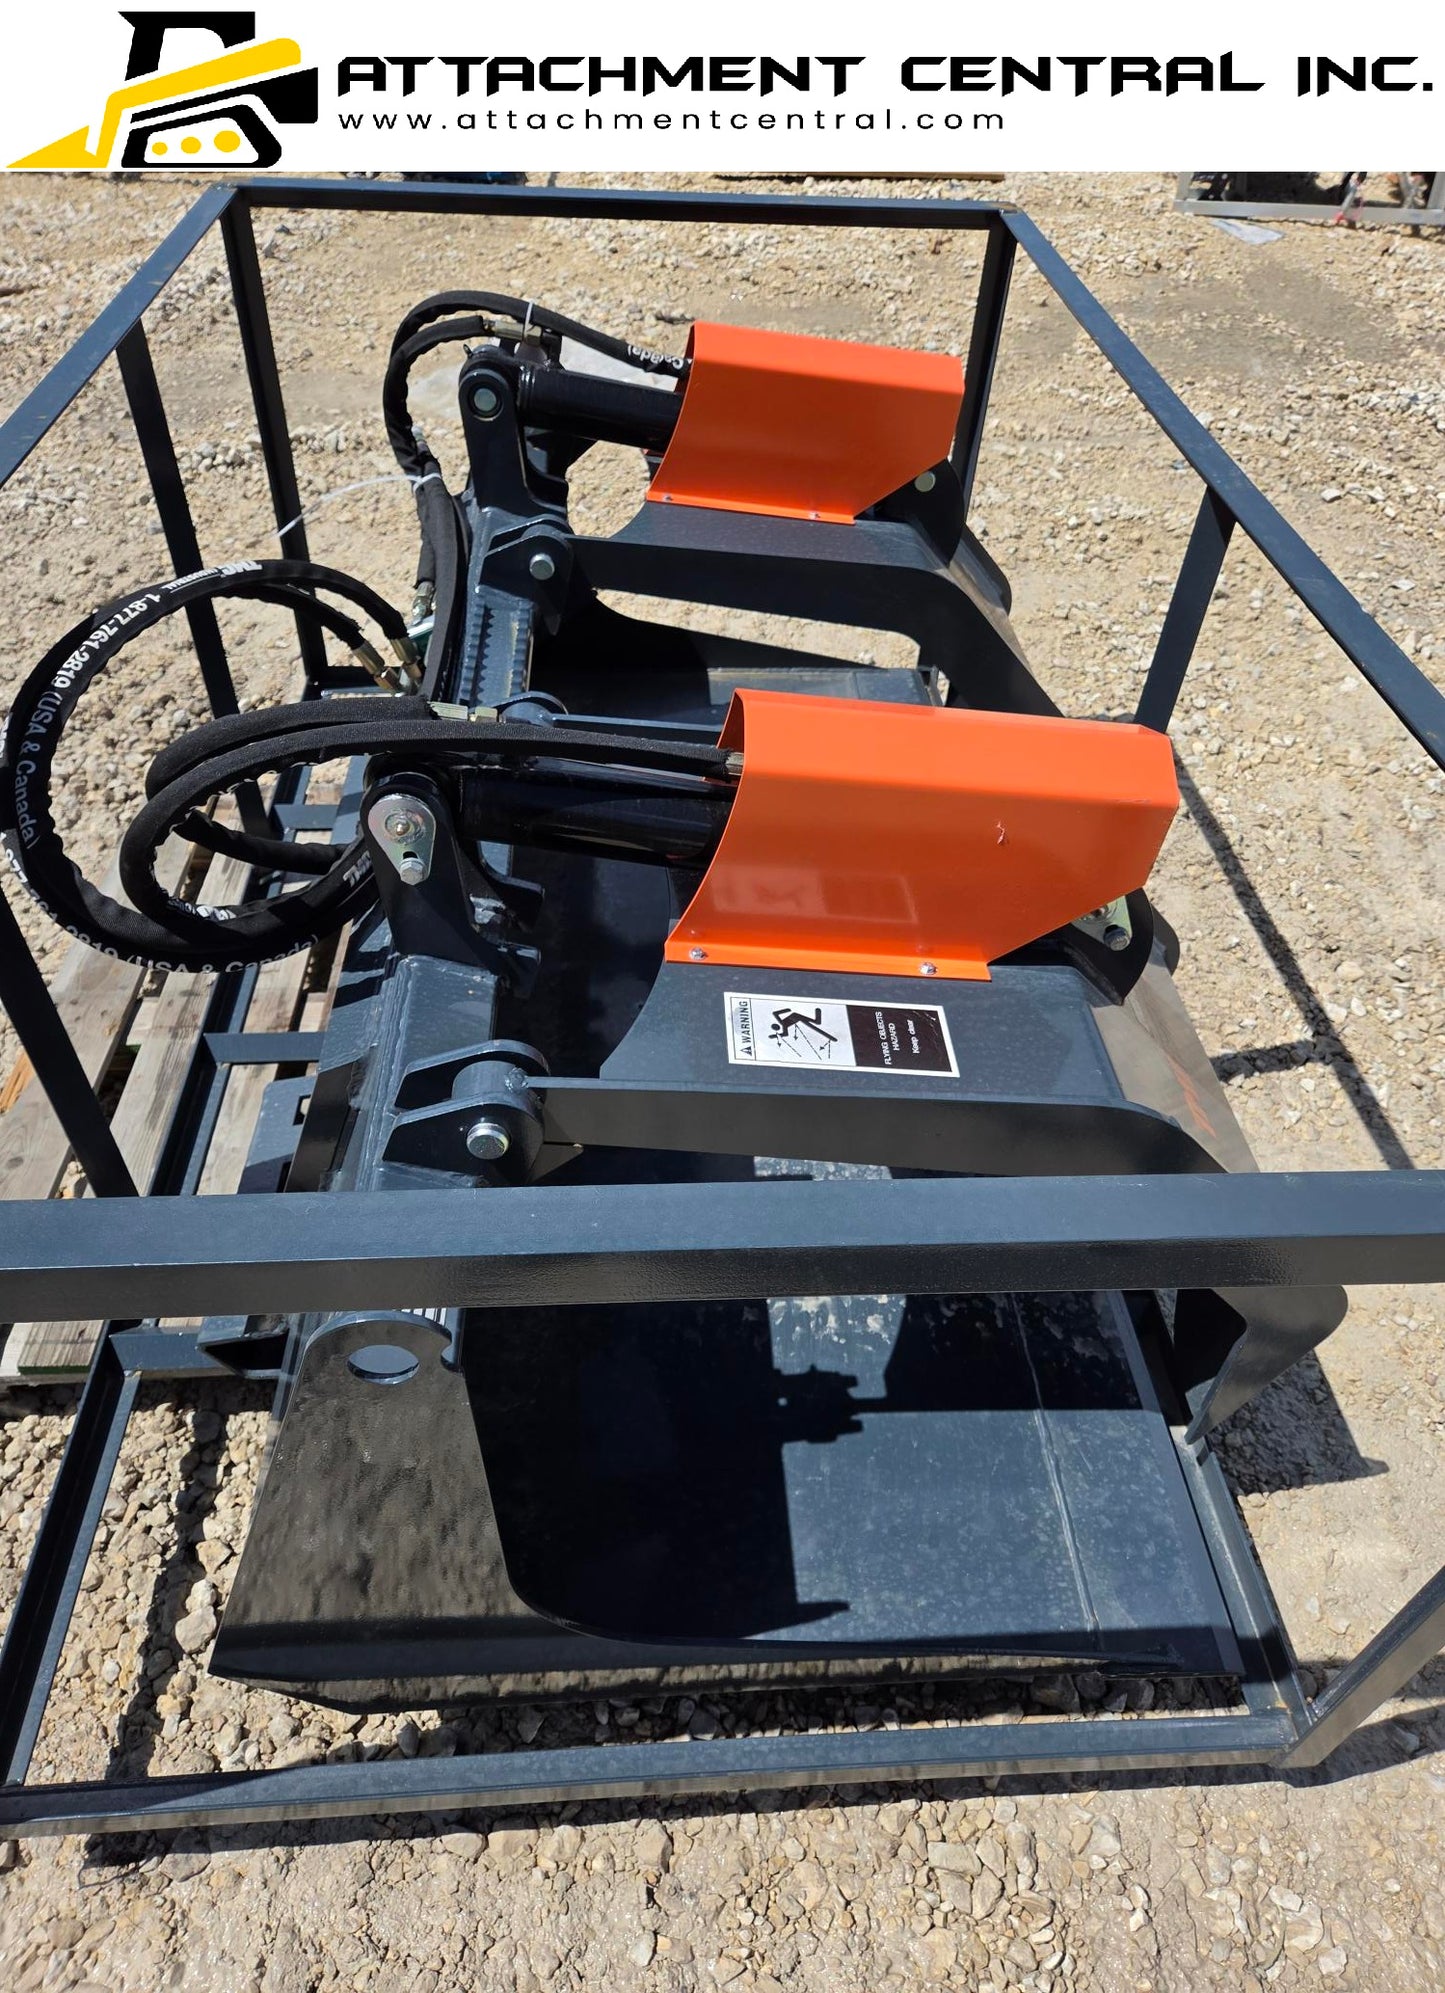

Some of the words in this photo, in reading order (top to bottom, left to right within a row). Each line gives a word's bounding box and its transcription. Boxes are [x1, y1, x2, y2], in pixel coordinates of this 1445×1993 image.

[52, 592, 161, 689] 1-877-761-2819
[24, 691, 64, 736] (USA
[19, 741, 41, 756] &
[14, 759, 41, 850] Canada)
[738, 1001, 752, 1044] WARNING
[875, 1011, 887, 1040] OBJECTS
[888, 1022, 900, 1051] HAZARD
[881, 1041, 892, 1065] FLYING
[911, 1036, 920, 1054] Keep
